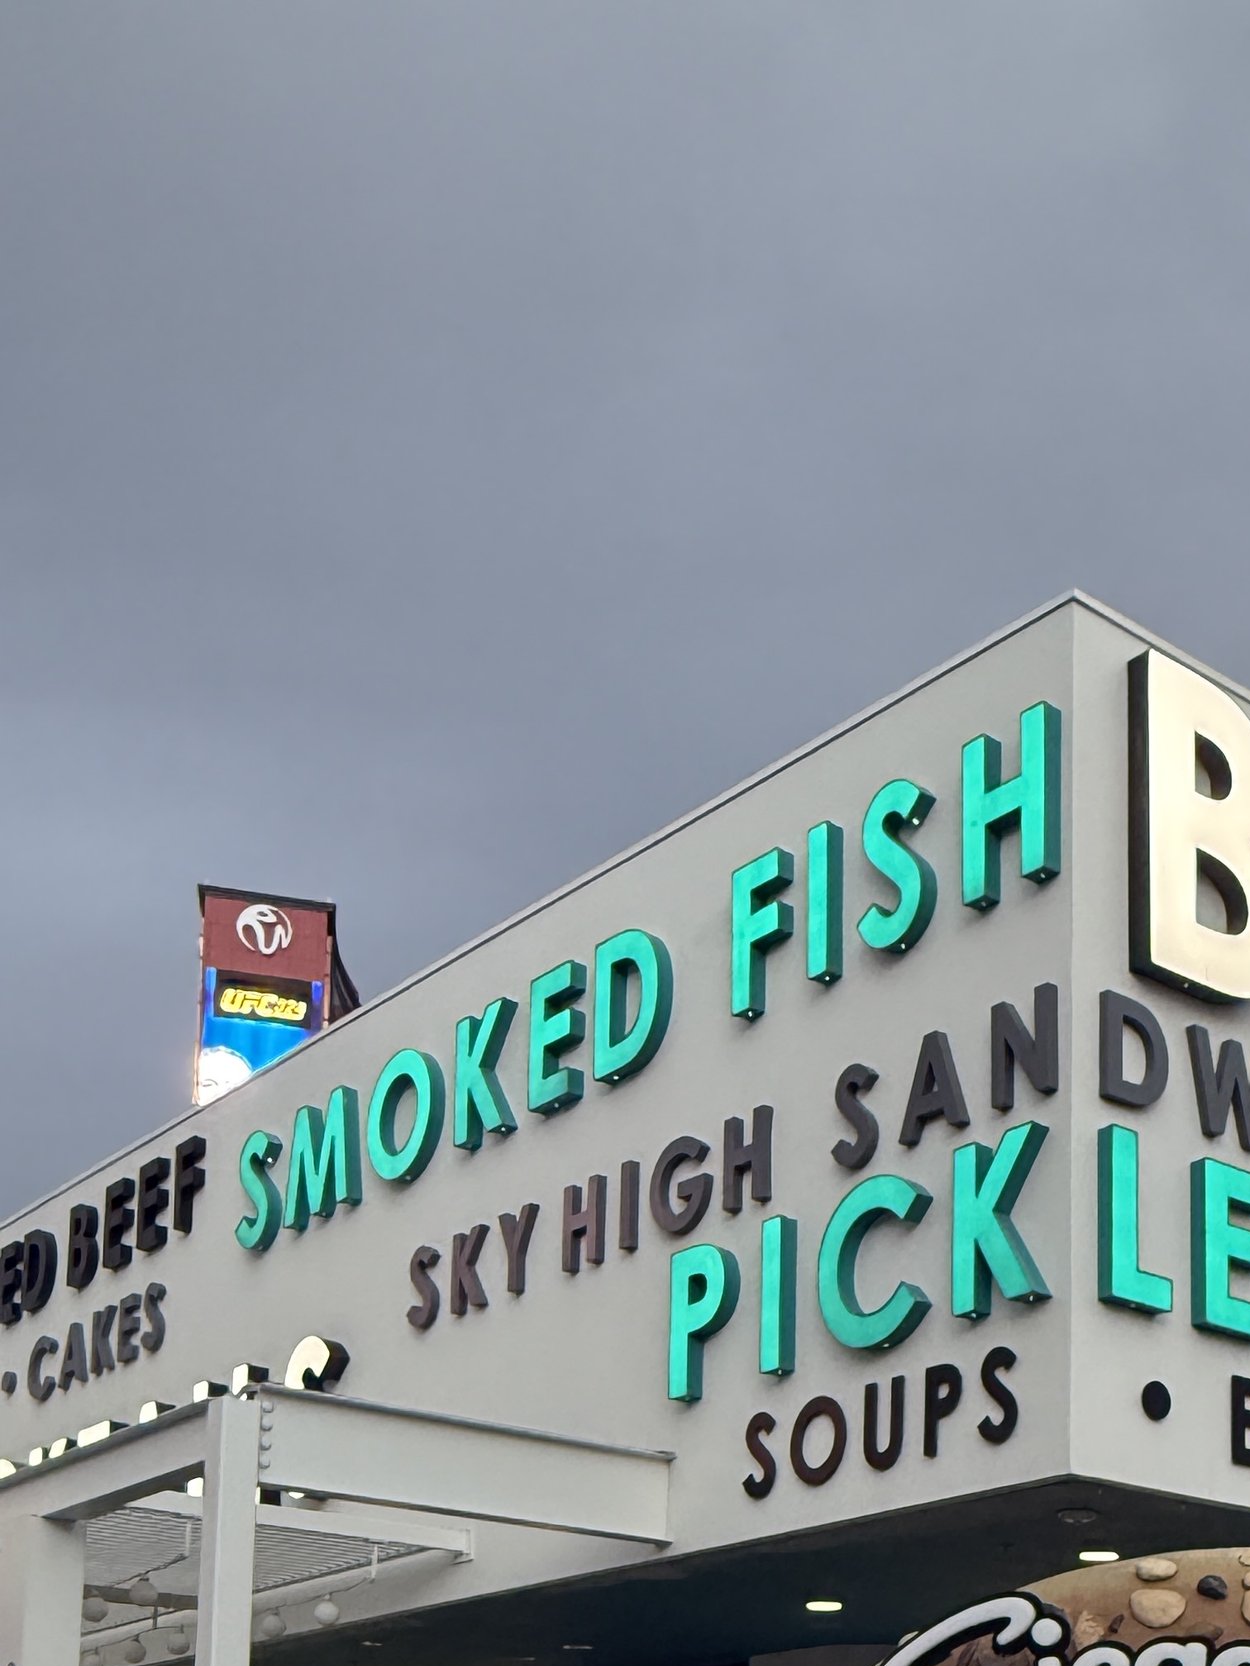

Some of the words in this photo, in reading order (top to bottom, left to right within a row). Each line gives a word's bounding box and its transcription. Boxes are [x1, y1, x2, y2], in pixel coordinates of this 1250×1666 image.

[220, 988, 280, 1018] UFC
[234, 928, 673, 1253] SMOKED
[731, 700, 1062, 1020] FISH
[66, 1135, 206, 1289] BEEF
[406, 1202, 540, 1331] SKY
[562, 1104, 774, 1274] HIGH
[28, 1282, 167, 1401] CAKES
[742, 1346, 1017, 1499] SOUPS
